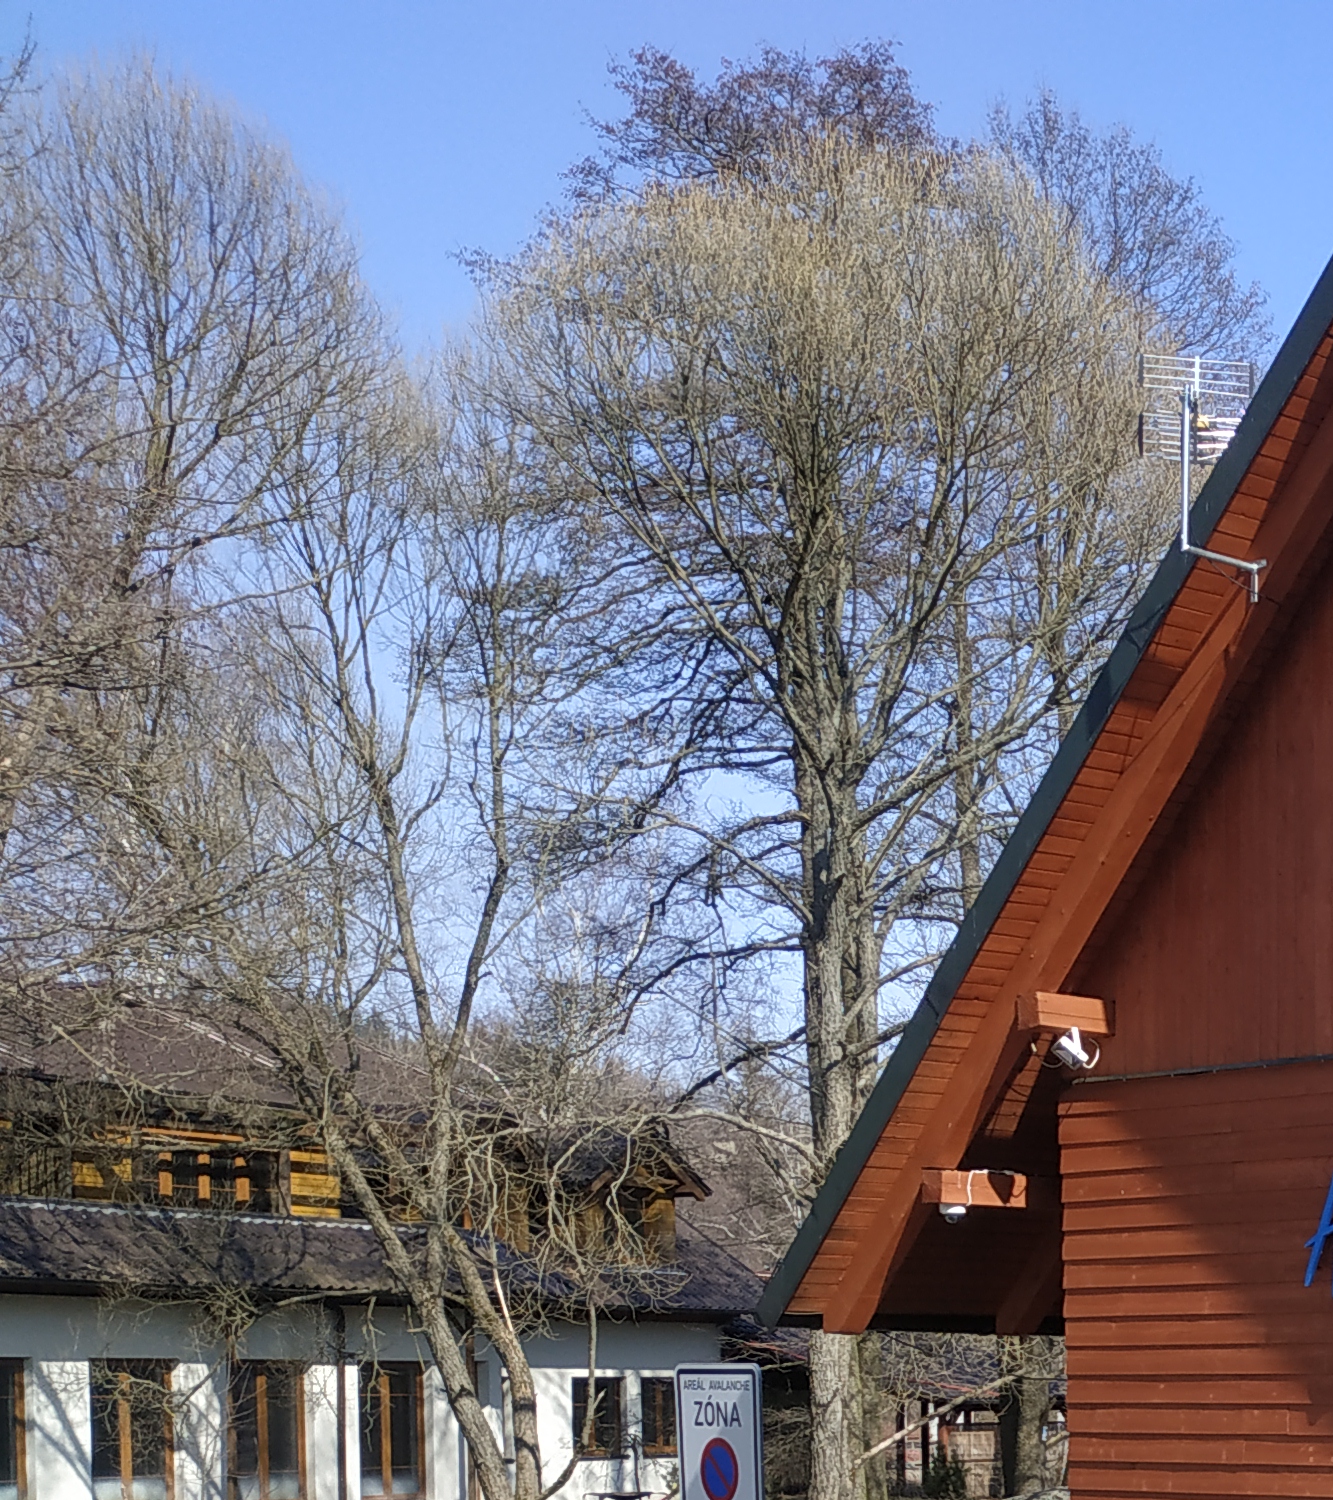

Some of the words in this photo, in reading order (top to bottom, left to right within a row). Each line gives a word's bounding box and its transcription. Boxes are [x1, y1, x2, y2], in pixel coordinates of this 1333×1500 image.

[683, 1377, 706, 1391] AREÁL
[709, 1379, 750, 1391] AVALANCHE
[693, 1394, 743, 1428] ZÓNA
